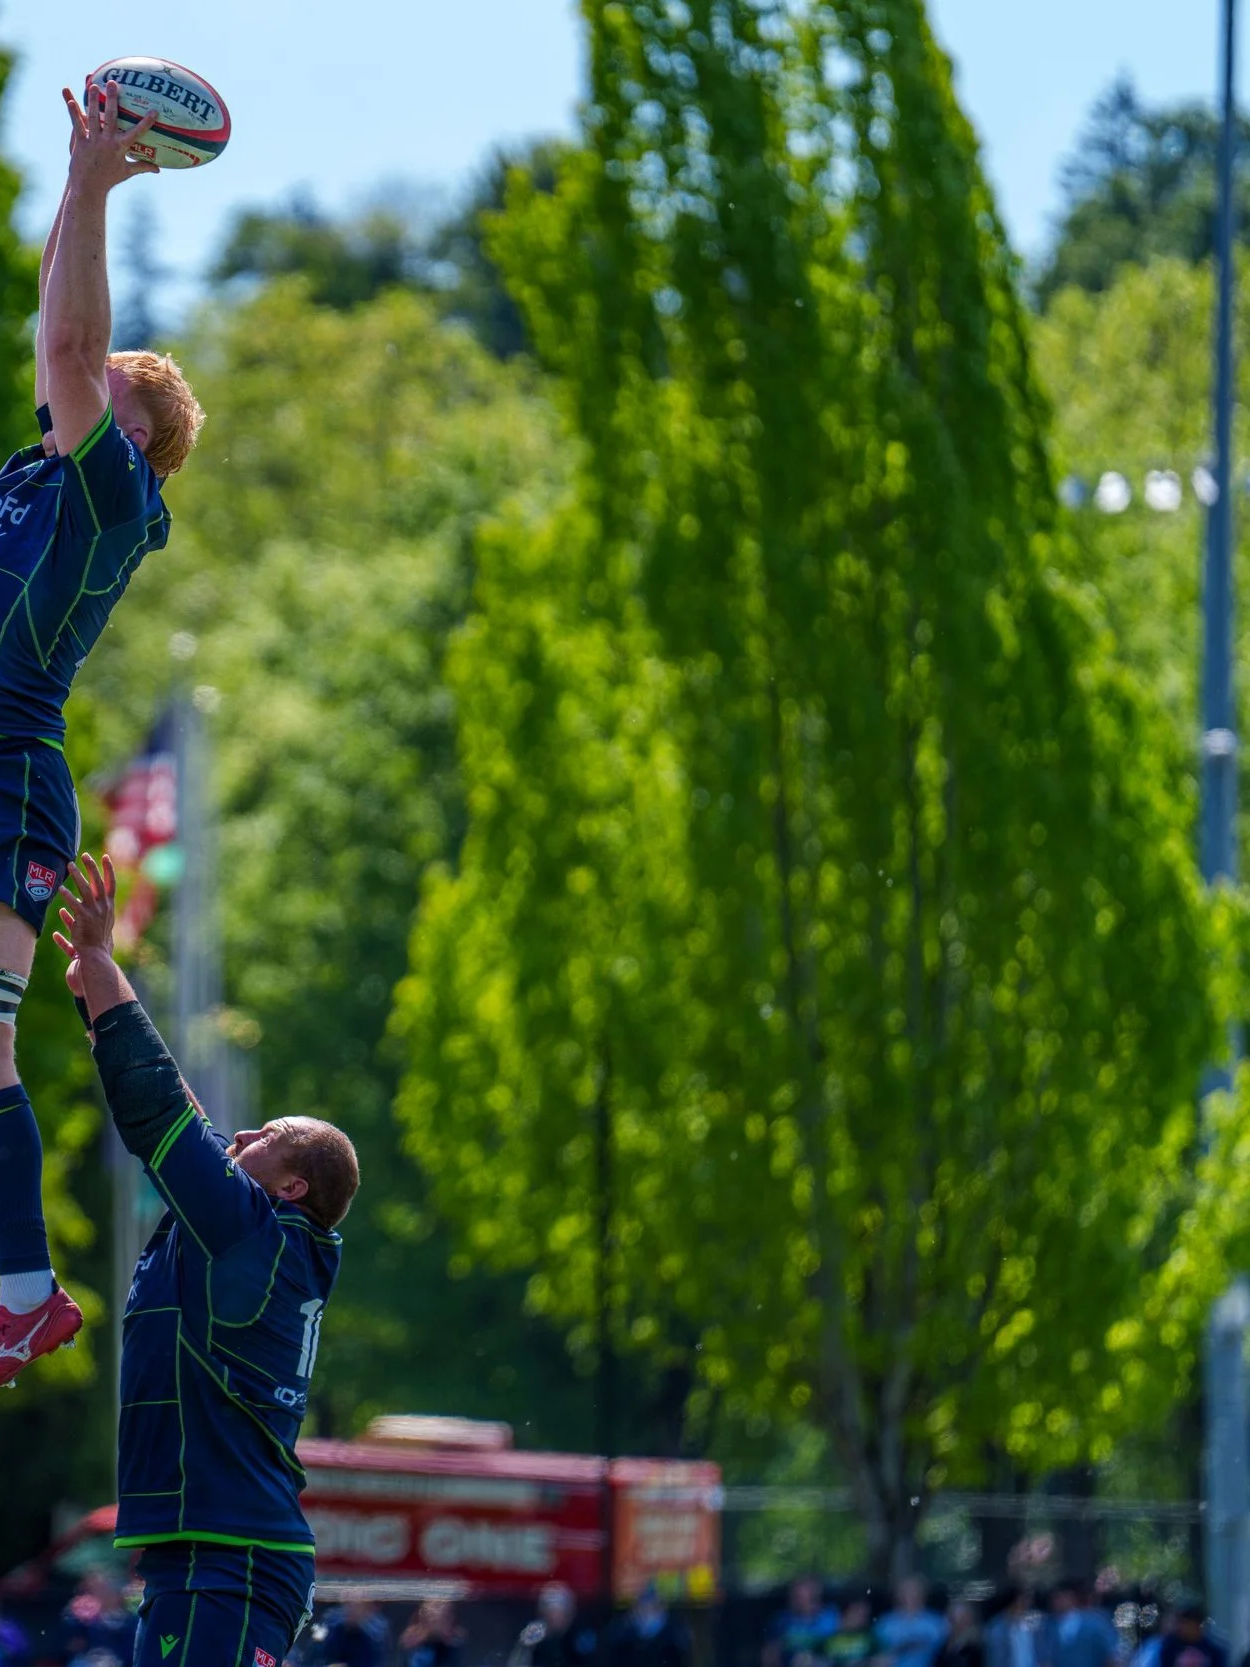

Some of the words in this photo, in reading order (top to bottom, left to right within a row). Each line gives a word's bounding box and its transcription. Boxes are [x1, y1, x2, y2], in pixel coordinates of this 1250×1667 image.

[104, 68, 215, 121] GILBERT
[30, 864, 53, 882] MLR
[256, 1650, 274, 1667] MLR
